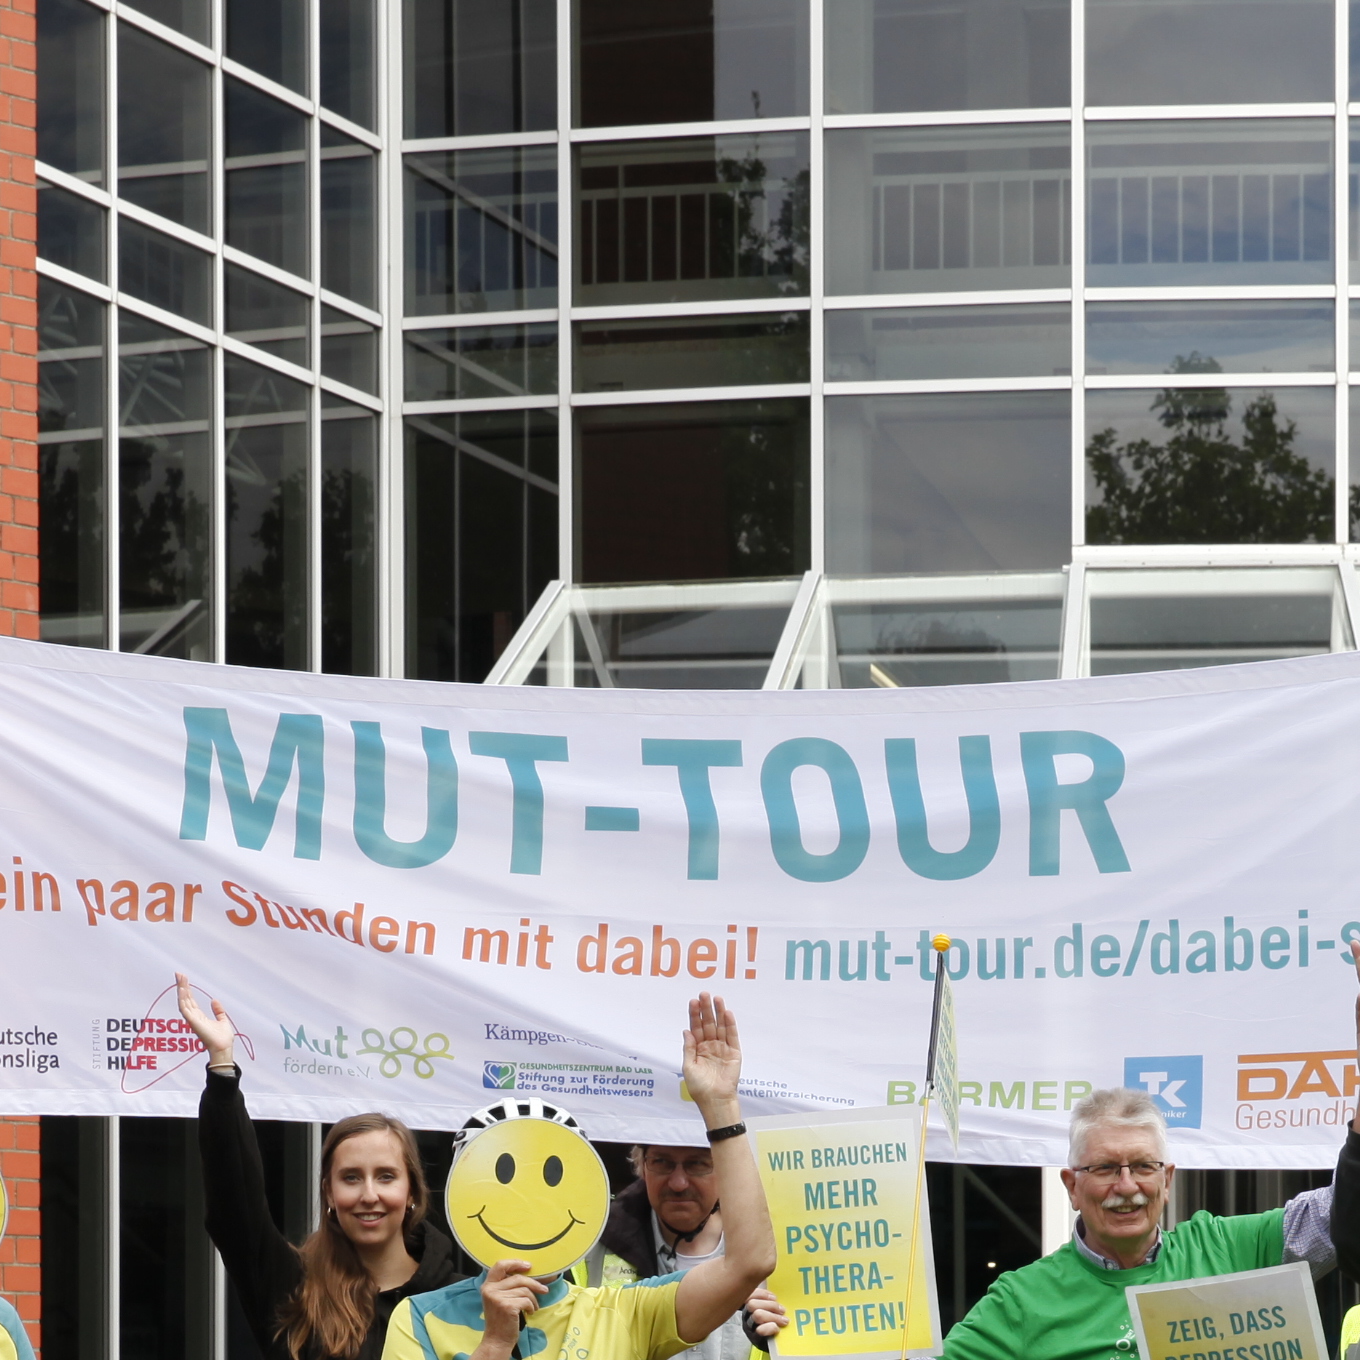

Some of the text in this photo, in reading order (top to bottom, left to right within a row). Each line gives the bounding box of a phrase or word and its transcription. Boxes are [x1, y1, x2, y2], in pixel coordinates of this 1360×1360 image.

[178, 704, 1132, 884] MUT-TOUR
[75, 877, 204, 926] paar
[224, 879, 437, 957] Stunden
[462, 916, 554, 971] mit
[574, 921, 759, 981] dabei!
[106, 1018, 194, 1035] DEUTSCH
[279, 1024, 349, 1060] Mut
[92, 1017, 101, 1070] STIFTUNG
[106, 1055, 158, 1071] HILFE
[283, 1057, 374, 1081] fördern e.V.
[519, 1062, 613, 1074] GESUNDHEITSZENTRUM
[615, 1066, 632, 1075] BAD
[517, 1081, 654, 1098] des Gesundheitswesens
[518, 1071, 654, 1089] Stiftung zur Förderung
[738, 1077, 788, 1089] eutsche
[1139, 1071, 1188, 1109] TK
[1235, 1101, 1357, 1131] Gesundh
[768, 1142, 907, 1171] WIR BRAUCHEN
[804, 1178, 878, 1211] MEHR
[786, 1218, 902, 1254] PSYCHO-
[798, 1261, 894, 1295] THERA-
[795, 1301, 906, 1336] PEUTEN!
[1166, 1305, 1286, 1344] ZEIG, DASS
